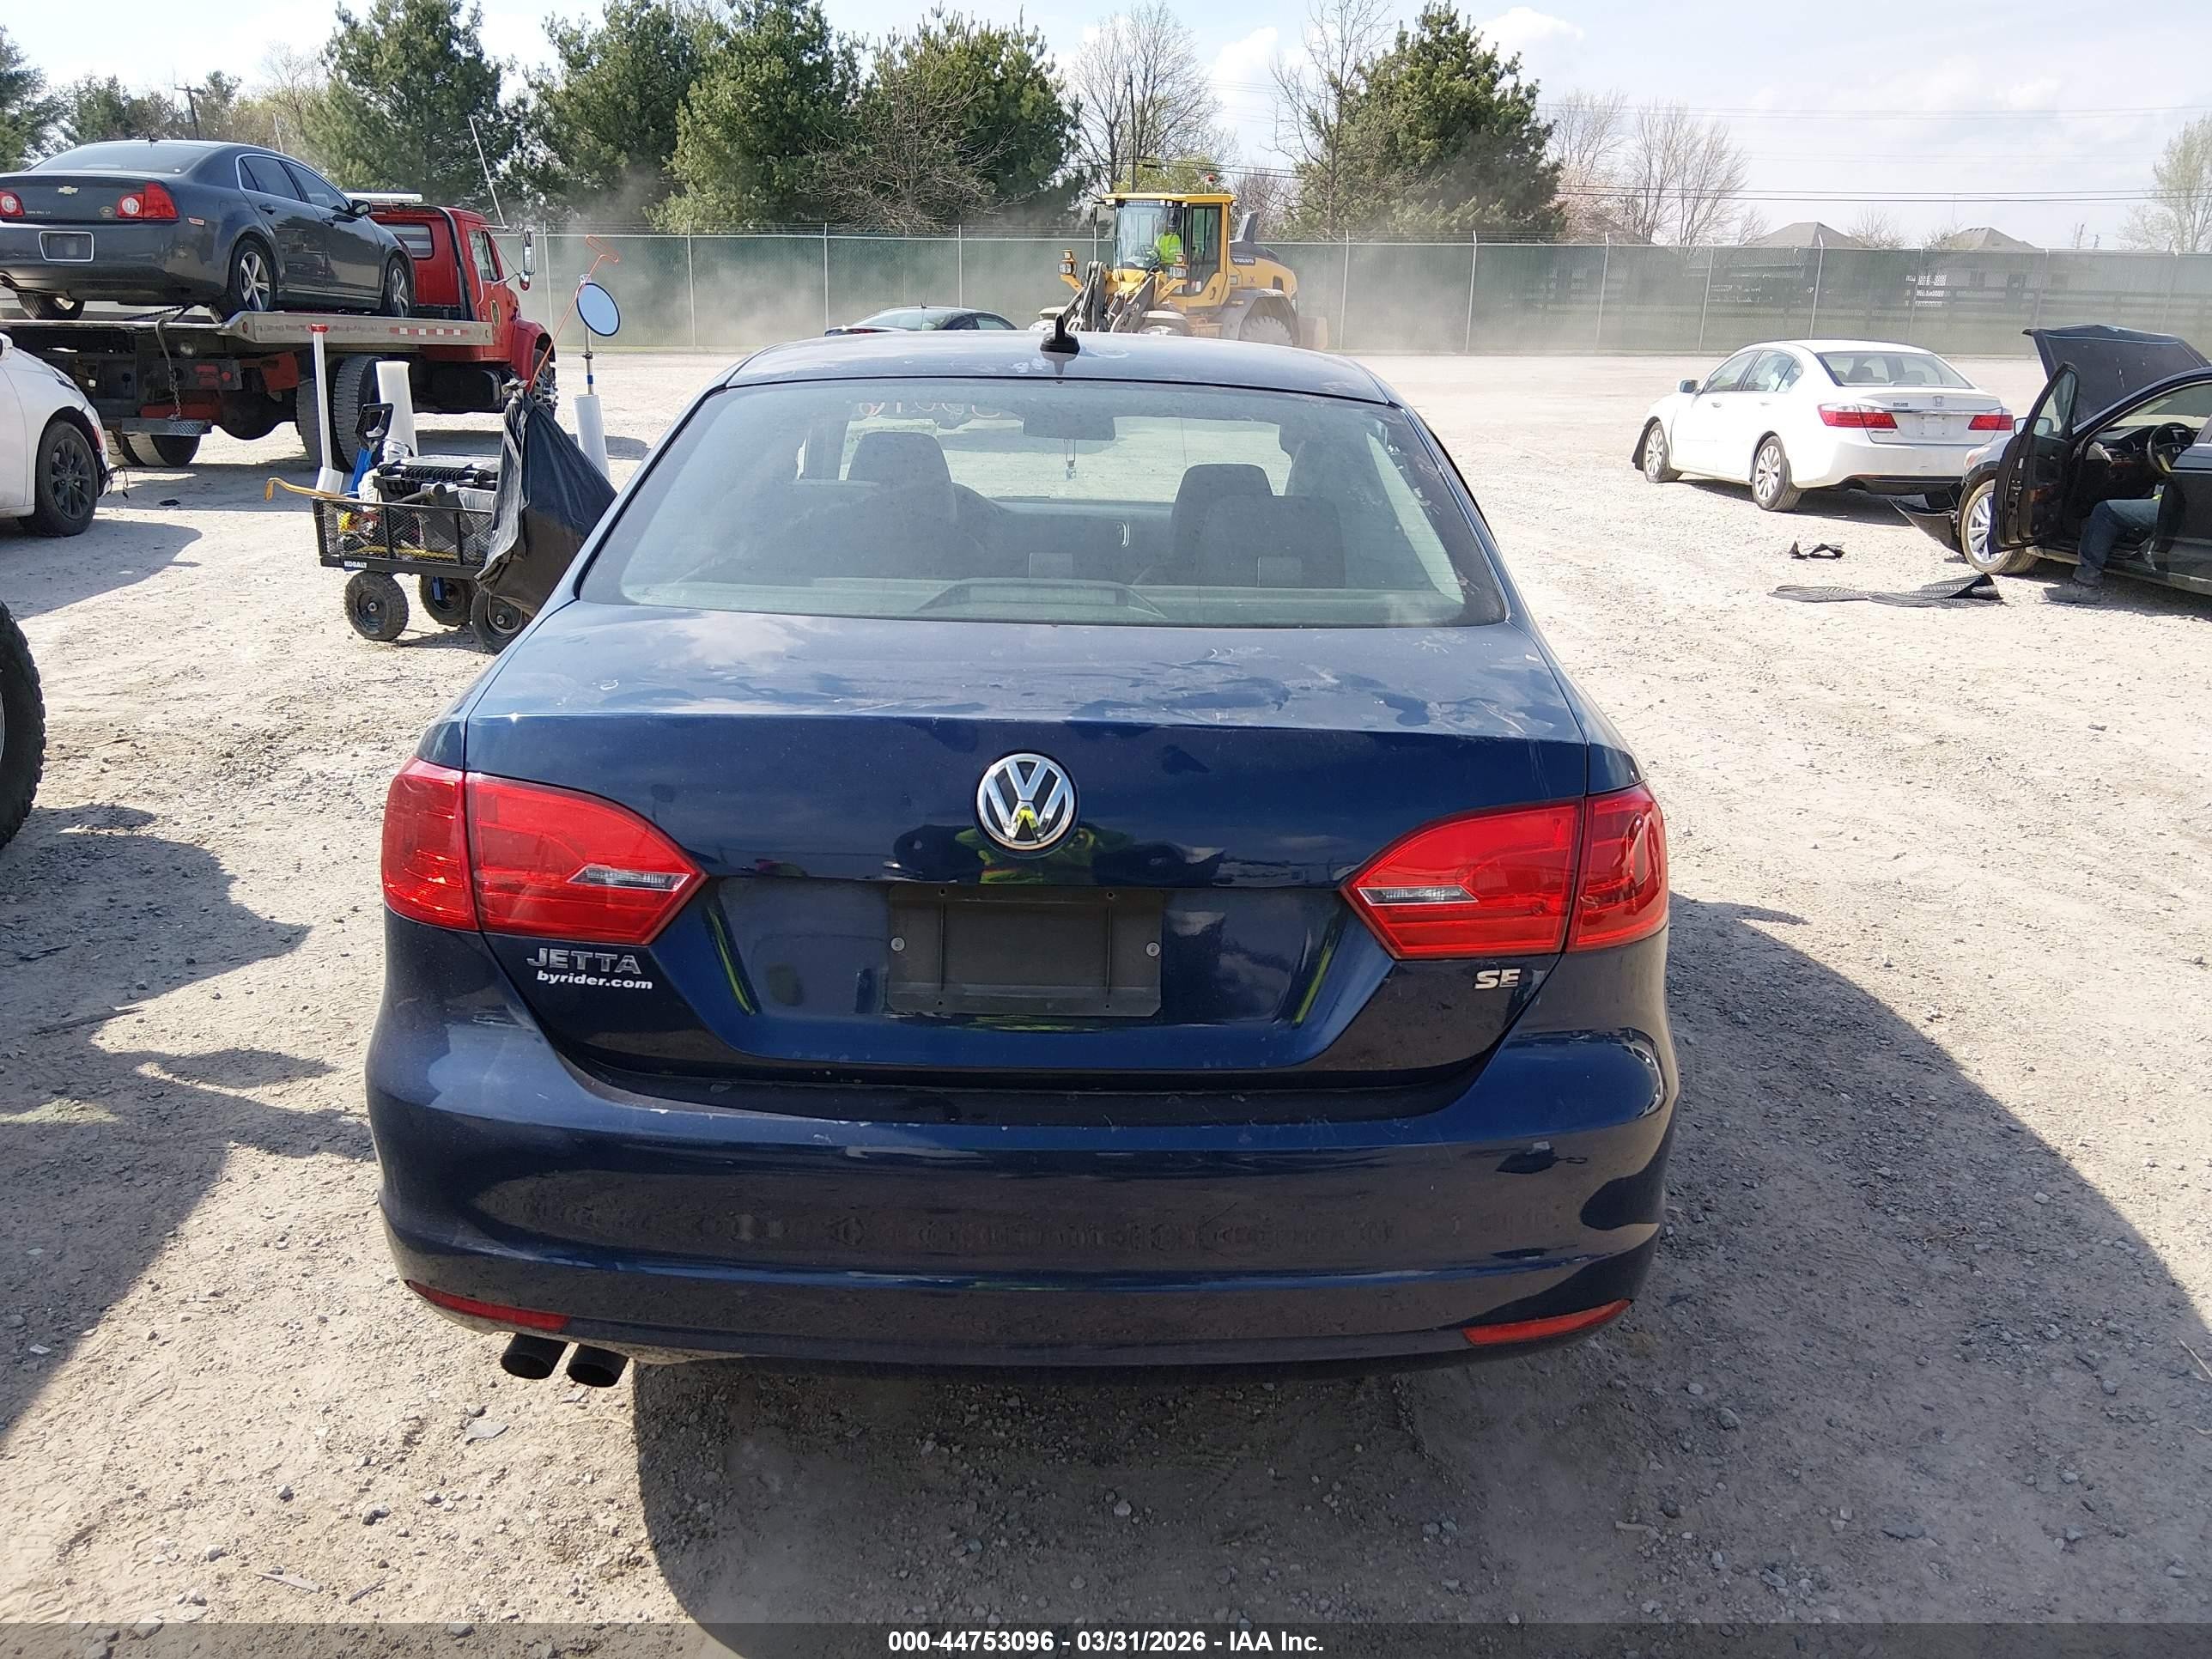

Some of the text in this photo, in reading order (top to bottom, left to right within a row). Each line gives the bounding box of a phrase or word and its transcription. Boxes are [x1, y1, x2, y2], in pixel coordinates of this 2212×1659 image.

[526, 948, 641, 974] JETTA
[537, 970, 653, 989] byrider.com
[1474, 968, 1522, 989] SE
